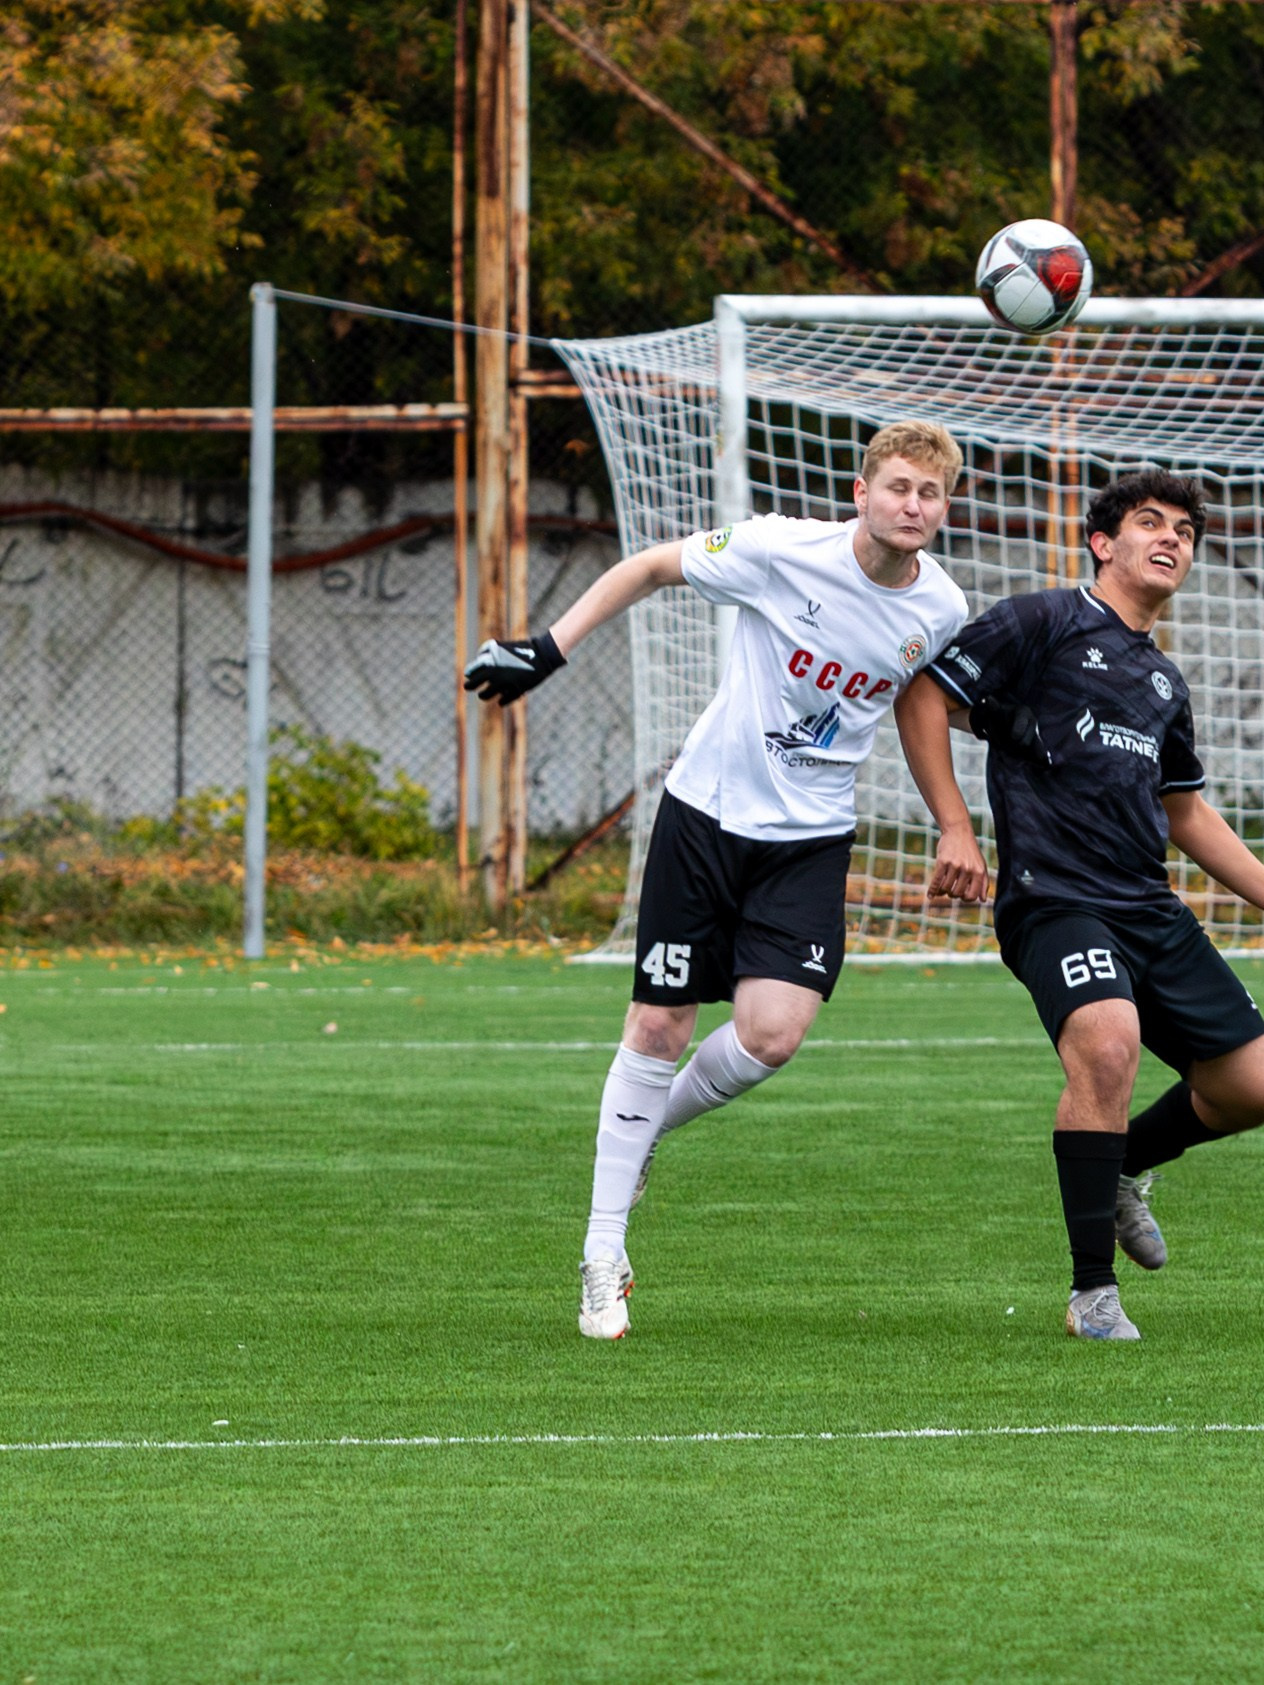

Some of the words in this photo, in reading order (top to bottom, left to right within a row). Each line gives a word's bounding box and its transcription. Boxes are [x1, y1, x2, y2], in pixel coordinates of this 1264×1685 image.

[788, 648, 893, 700] СССР
[641, 941, 692, 988] 45
[1060, 948, 1117, 989] 69
